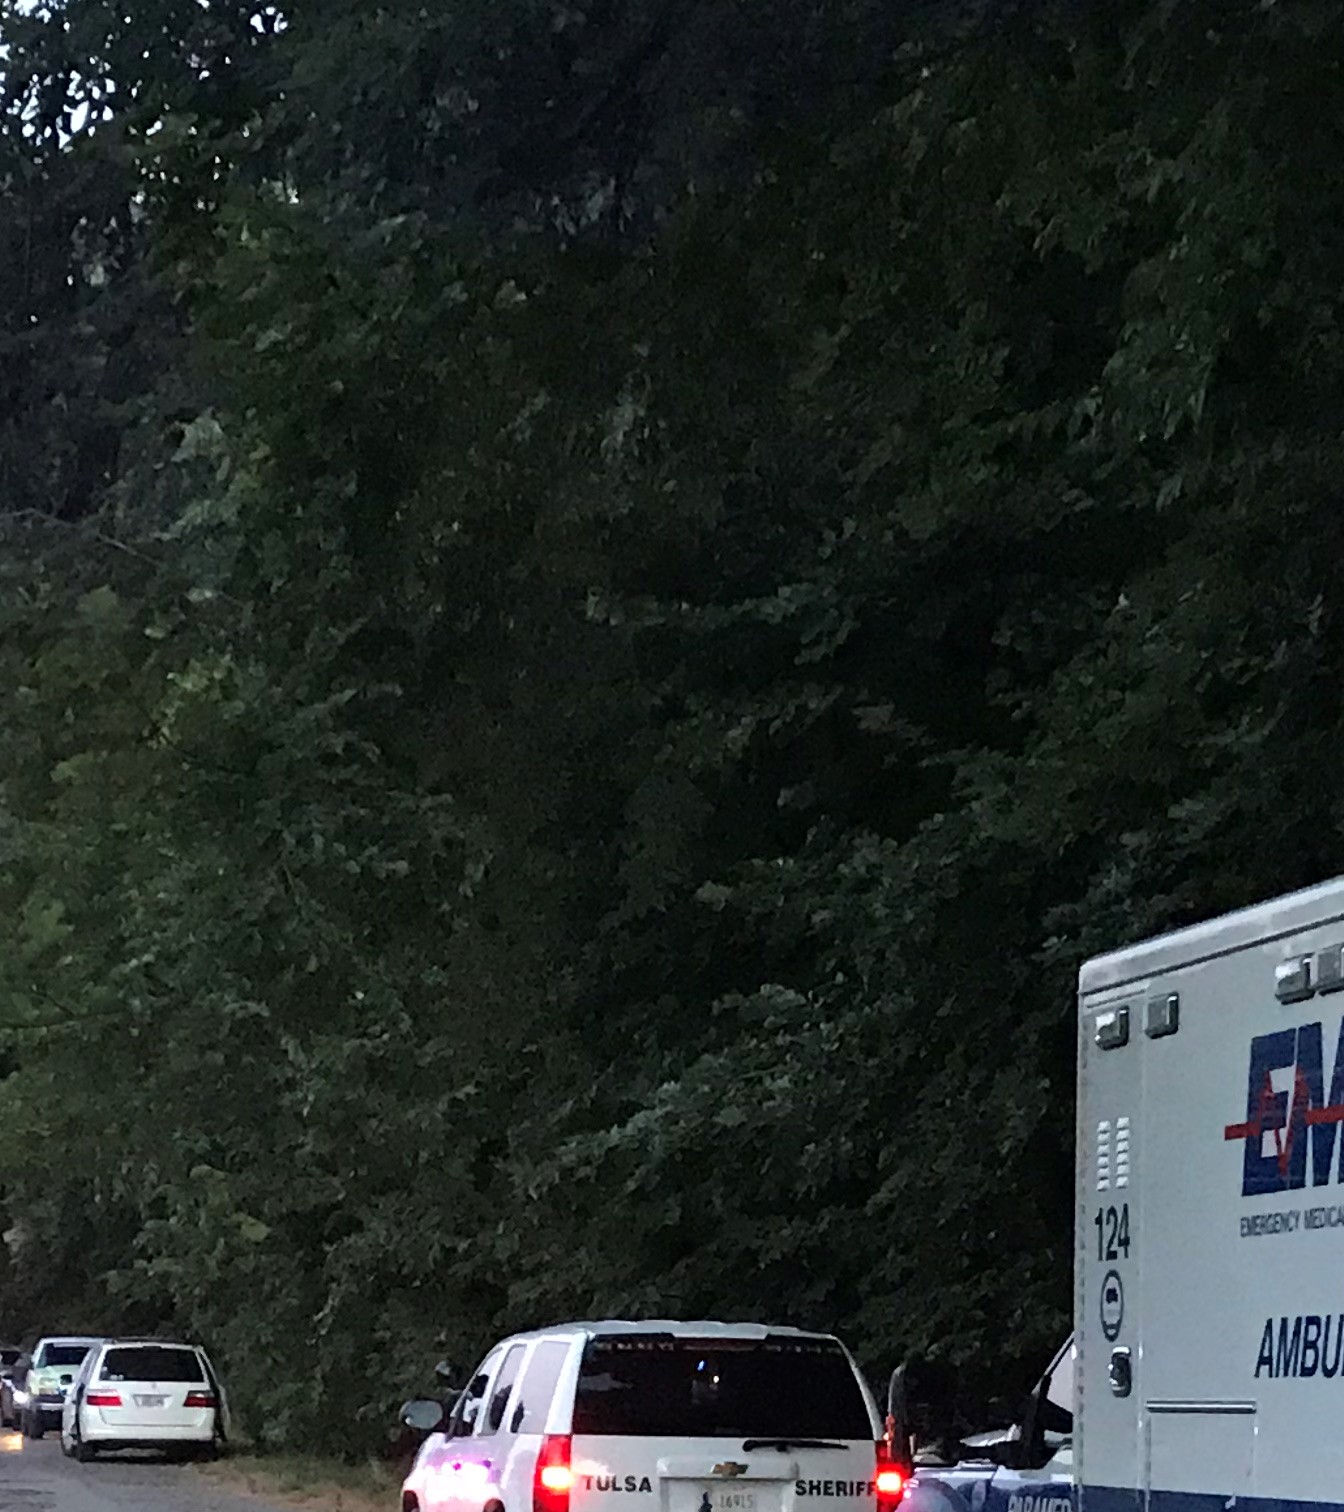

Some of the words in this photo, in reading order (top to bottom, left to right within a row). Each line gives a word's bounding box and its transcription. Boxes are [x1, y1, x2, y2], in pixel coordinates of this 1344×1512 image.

[1094, 1203, 1131, 1262] 124
[1240, 1210, 1300, 1239] EMERGENCY
[581, 1475, 653, 1493] TULSA
